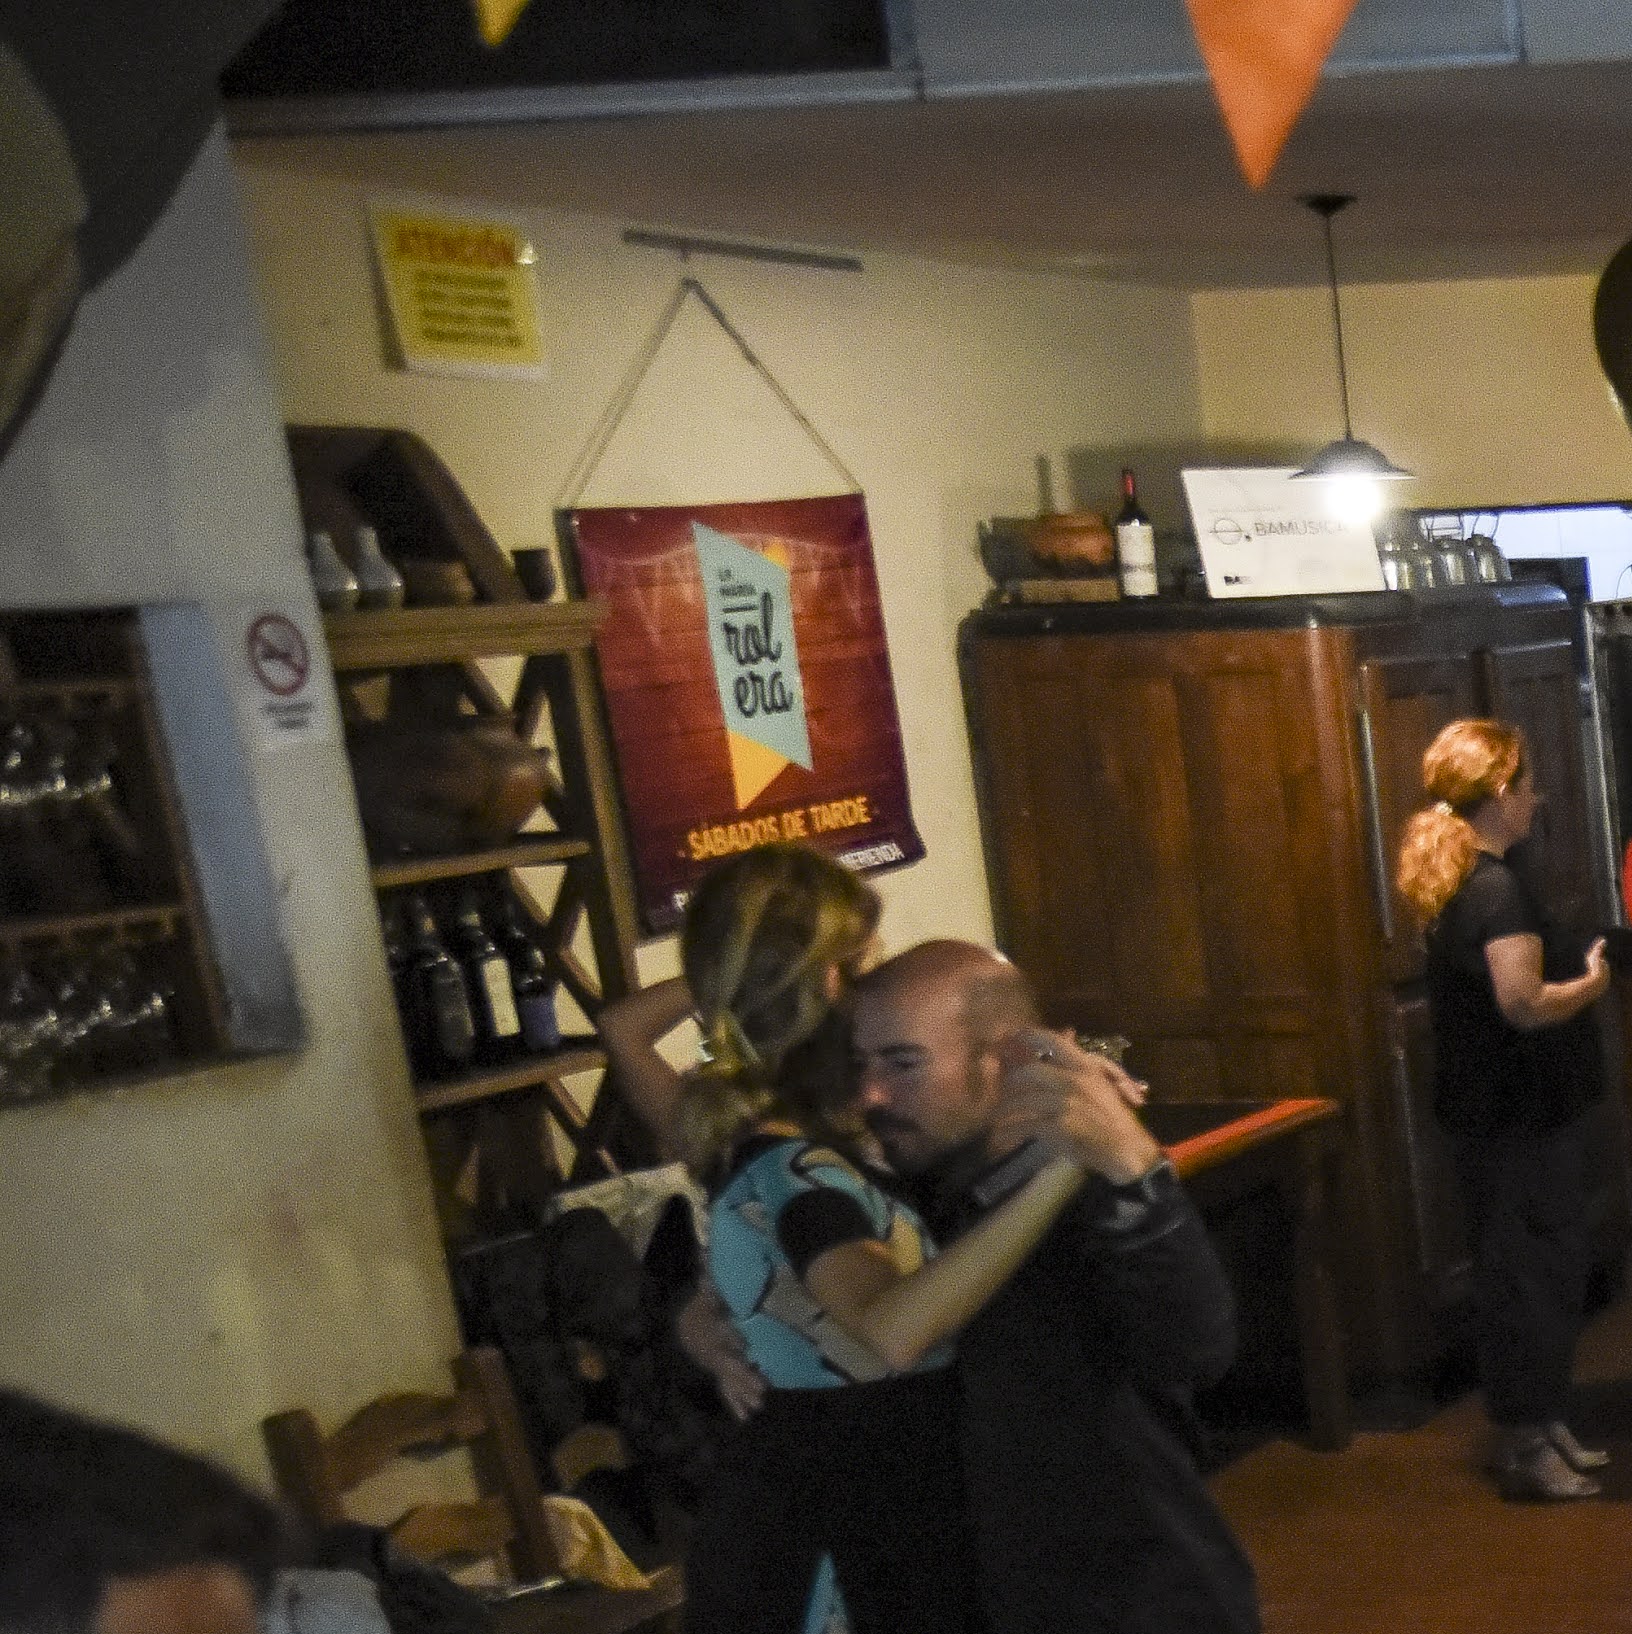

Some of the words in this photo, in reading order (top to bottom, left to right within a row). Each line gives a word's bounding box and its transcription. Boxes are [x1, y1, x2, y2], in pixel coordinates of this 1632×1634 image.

[733, 670, 794, 719] era
[782, 809, 809, 840] DE
[809, 796, 872, 833] TARDE
